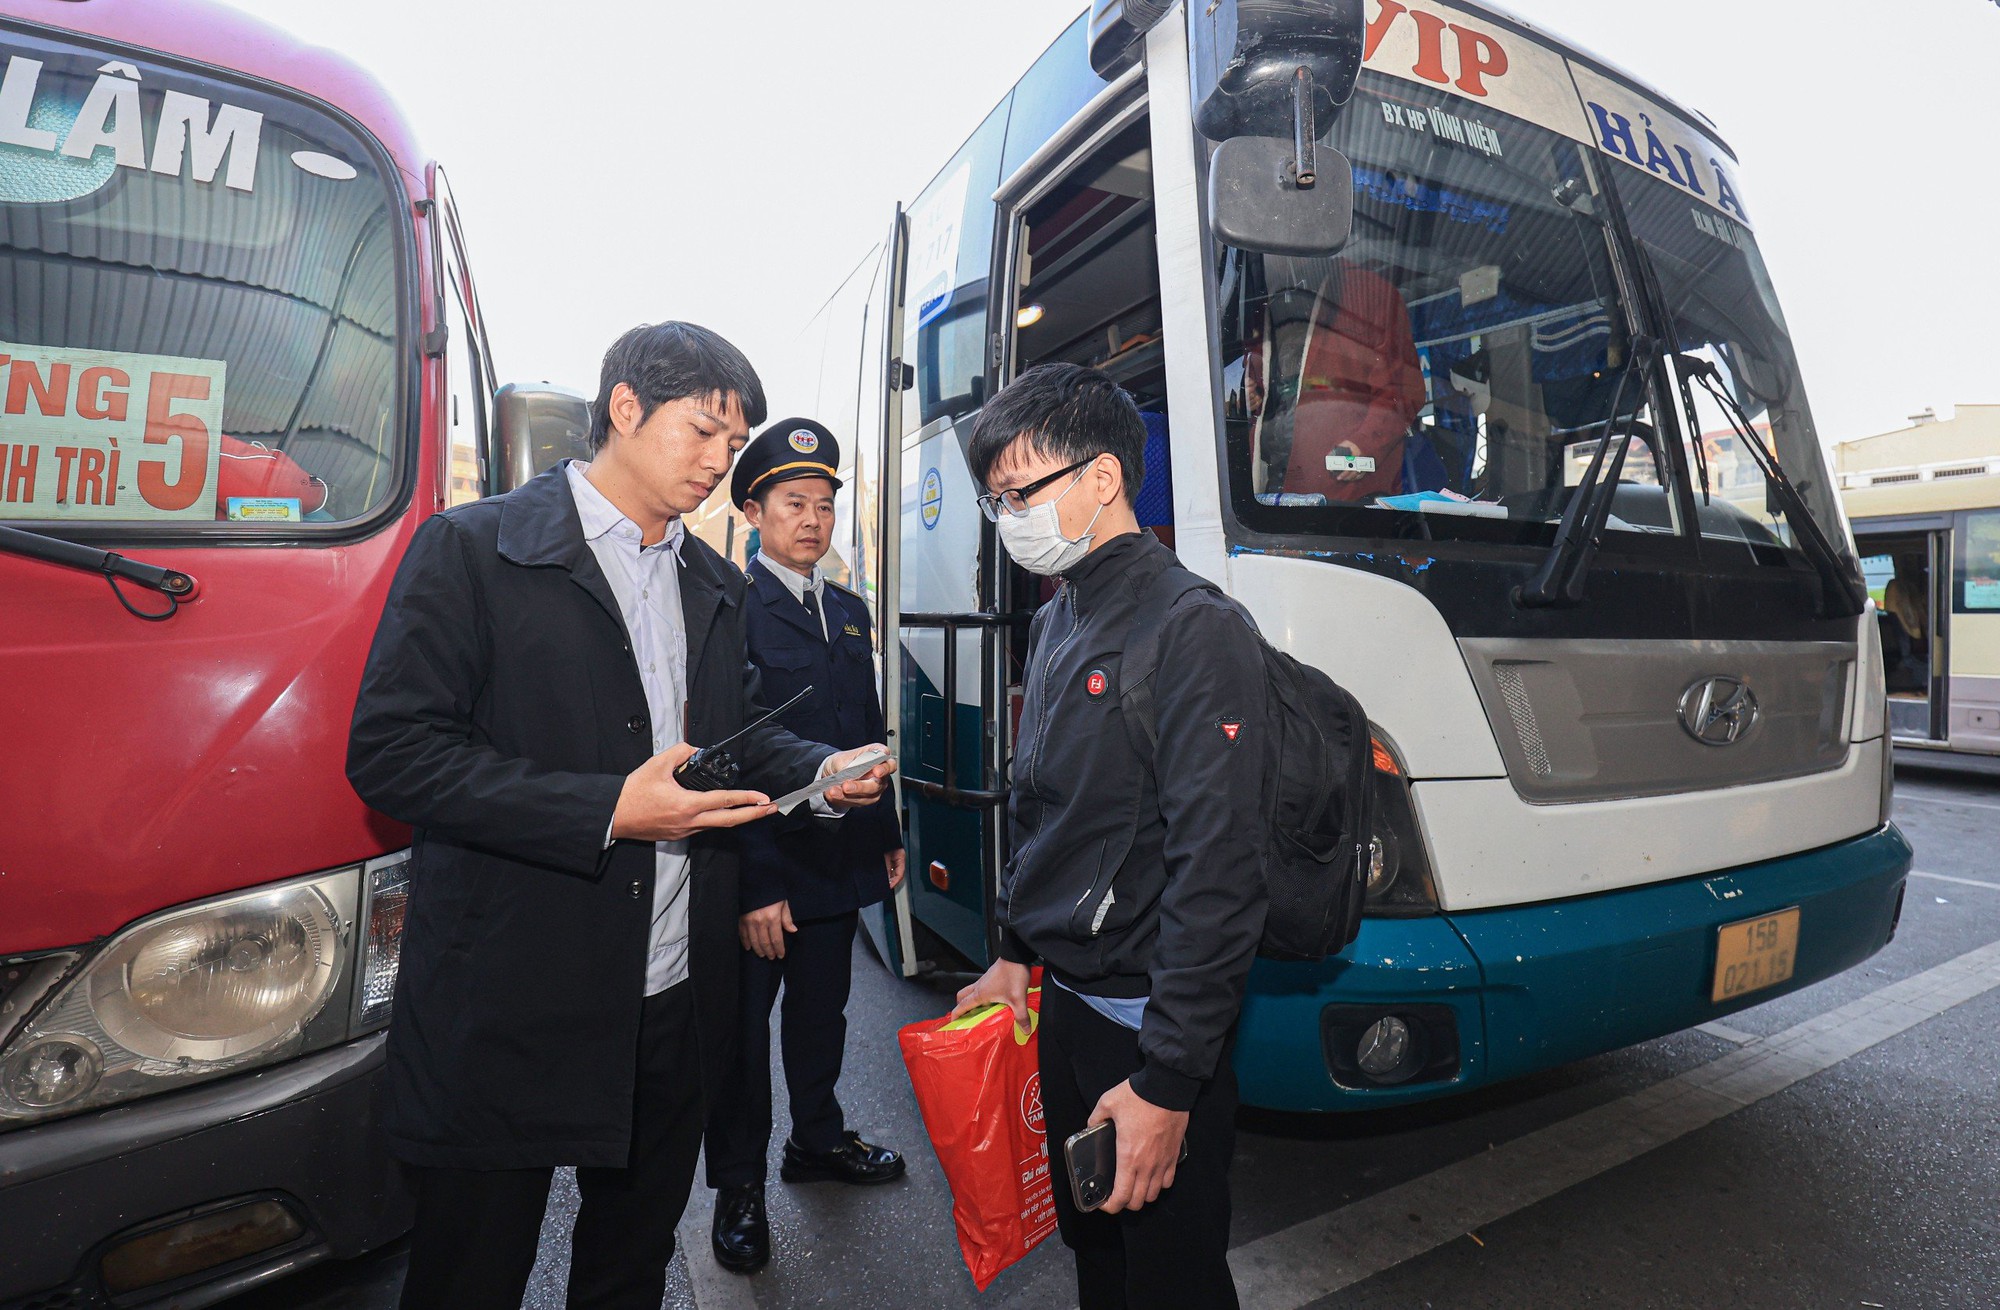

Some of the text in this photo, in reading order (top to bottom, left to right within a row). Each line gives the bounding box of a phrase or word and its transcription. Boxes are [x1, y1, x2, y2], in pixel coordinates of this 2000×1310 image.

[0, 55, 264, 193] LÂM
[1381, 101, 1502, 157] BX HP VĨNH NIỆM
[1587, 101, 1705, 196] HẢI
[0, 354, 130, 421] NG
[55, 437, 121, 505] TRÌ
[137, 371, 211, 511] 5
[1746, 919, 1778, 956] 15B
